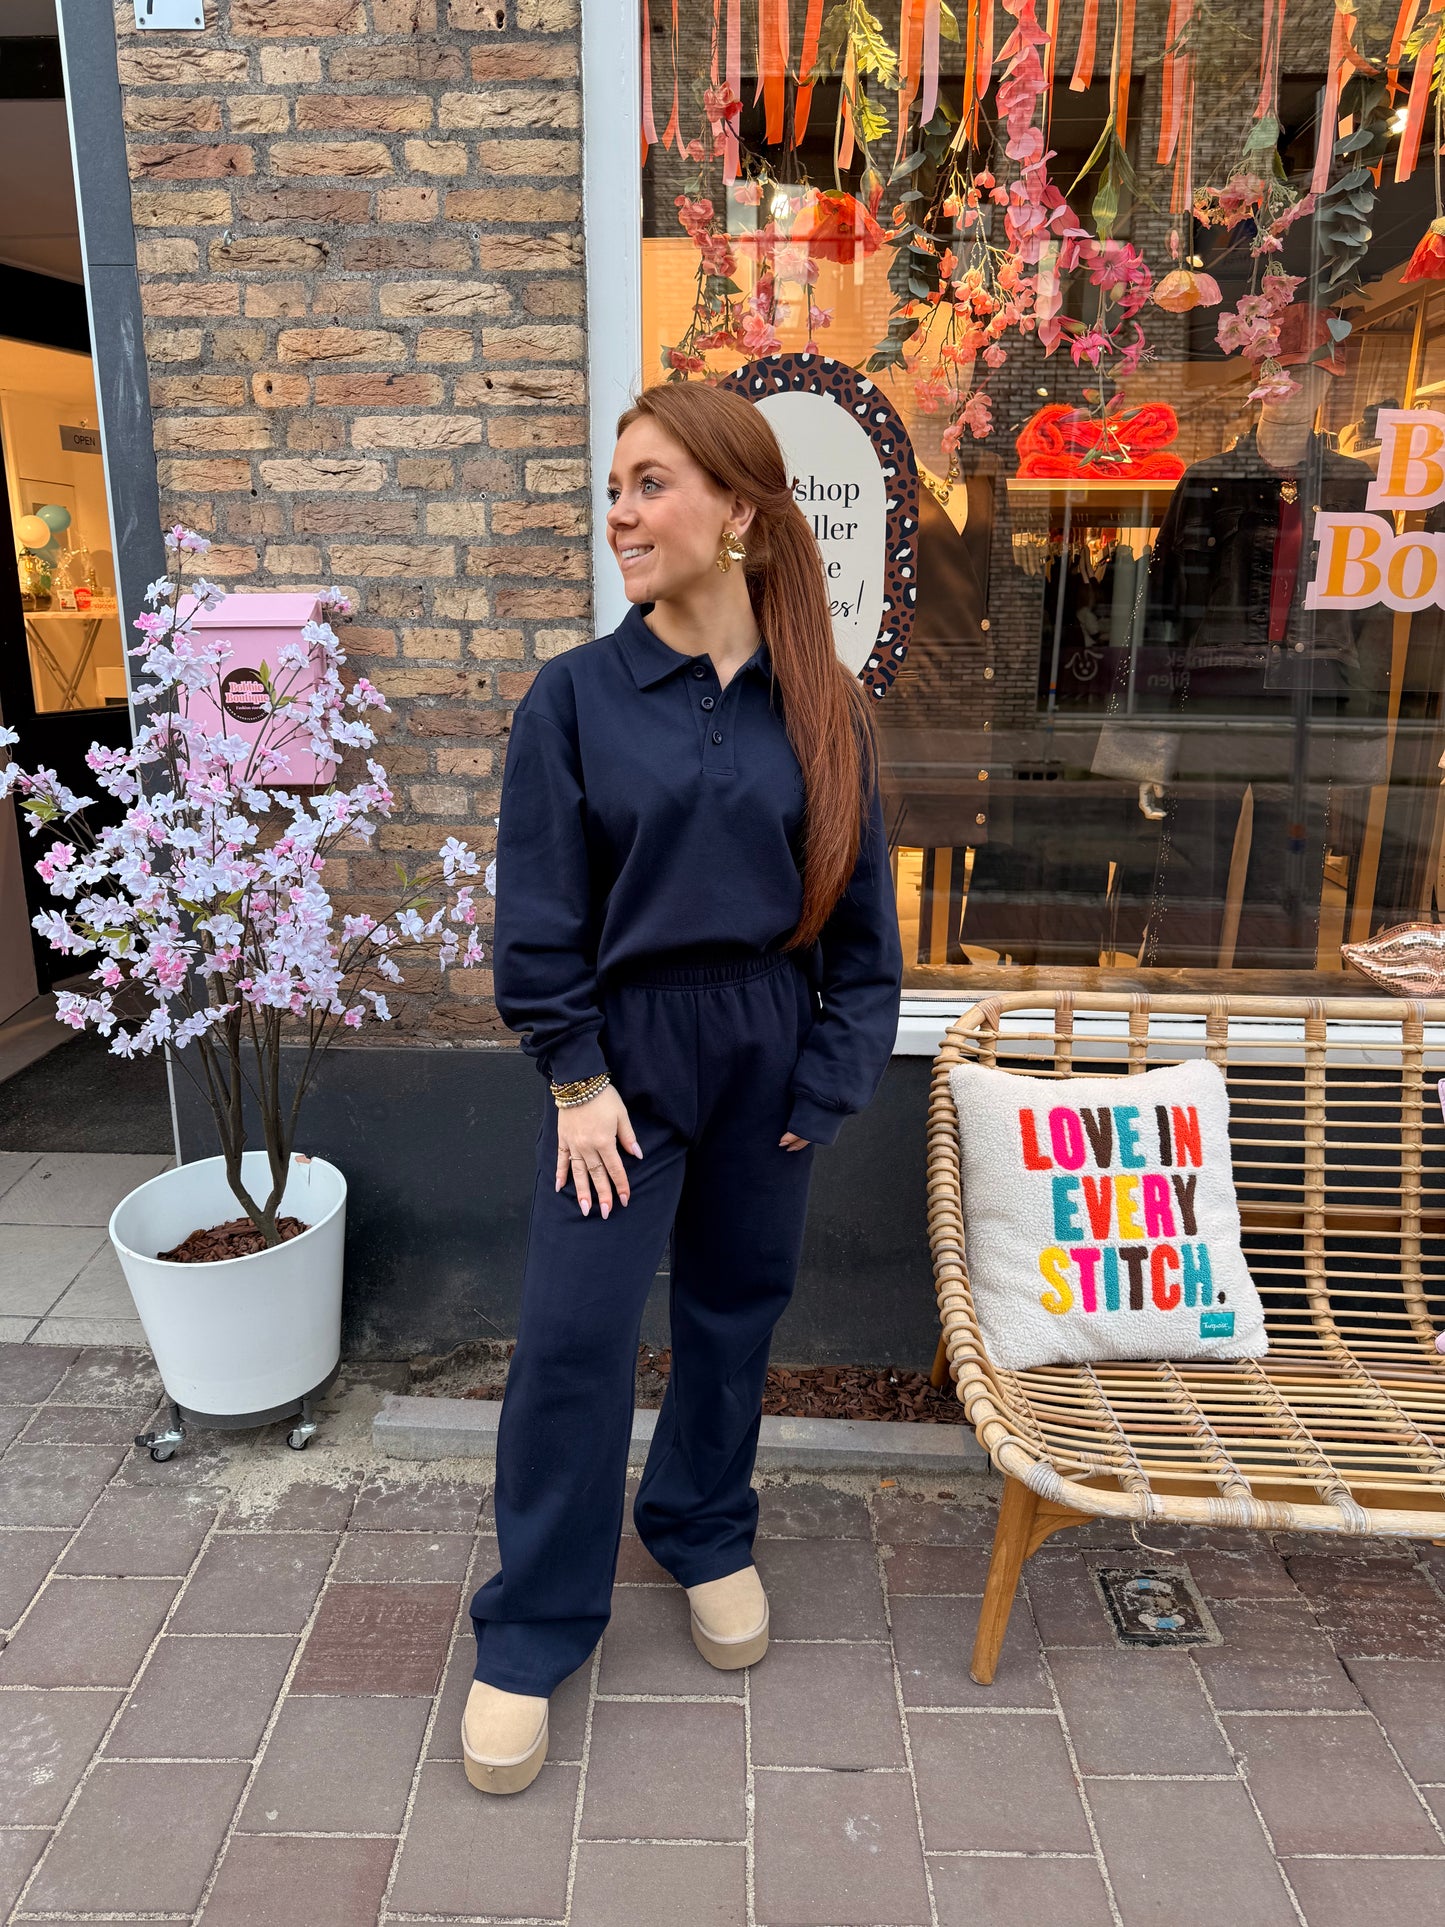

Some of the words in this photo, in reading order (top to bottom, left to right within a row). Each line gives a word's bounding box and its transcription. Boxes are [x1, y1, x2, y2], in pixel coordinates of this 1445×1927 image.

[73, 434, 96, 446] OPEN
[1380, 422, 1445, 498] B
[804, 514, 858, 541] ller
[1318, 525, 1445, 600] Bo
[827, 579, 865, 626] es!
[225, 692, 269, 704] Boutique
[229, 681, 264, 692] Bobbie
[1019, 1106, 1146, 1171] LOVE
[1155, 1105, 1203, 1168] IN
[1051, 1174, 1198, 1241] EVERY
[1038, 1243, 1226, 1315] STITCH.
